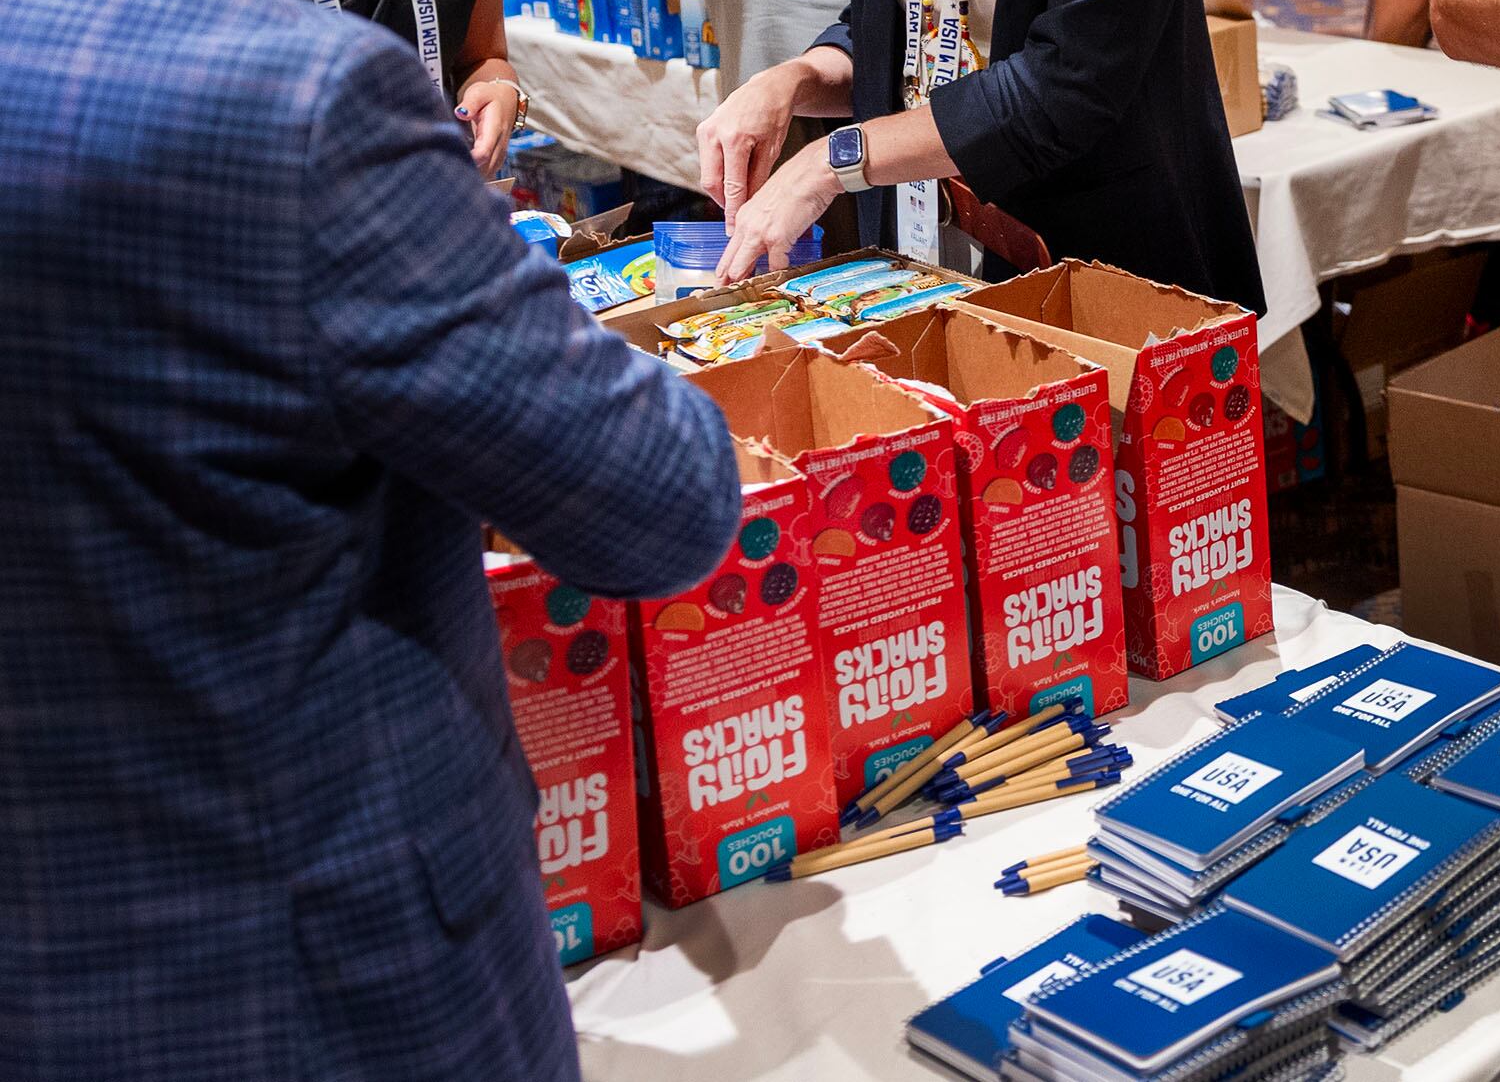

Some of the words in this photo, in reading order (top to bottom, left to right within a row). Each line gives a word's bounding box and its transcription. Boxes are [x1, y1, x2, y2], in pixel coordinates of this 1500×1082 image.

[423, 28, 438, 63] TEAM
[940, 18, 959, 53] USA
[1213, 335, 1231, 347] FREE
[1231, 327, 1249, 341] GLUTEN
[1175, 340, 1208, 360] NATURALLY
[1150, 357, 1164, 368] FREE
[1055, 393, 1071, 404] FREE
[1071, 384, 1097, 398] GLUTEN
[978, 415, 996, 426] FREE
[1185, 418, 1200, 431] CHERRY
[1234, 405, 1256, 430] RASPBERRY
[1196, 484, 1229, 502] FLAVORED
[1230, 476, 1249, 491] FRUIT
[1168, 498, 1195, 513] SNACKS
[1076, 542, 1099, 557] FRUIT
[1035, 550, 1075, 570] FLAVORED
[1002, 563, 1034, 581] SNACKS
[915, 595, 942, 610] FRUIT
[1211, 589, 1240, 609] Member's
[870, 604, 915, 624] FLAVORED
[1197, 609, 1235, 632] POUCHES
[833, 618, 868, 636] SNACKS
[1198, 622, 1238, 652] 100
[1053, 661, 1089, 679] Member's
[721, 679, 771, 702] FLAVORED
[1038, 683, 1083, 706] POUCHES
[1361, 692, 1406, 713] USA
[1332, 705, 1354, 716] ONE
[1352, 709, 1374, 722] FOR
[1372, 715, 1391, 729] ALL
[874, 744, 923, 768] POUCHES
[1202, 768, 1250, 793] USA
[727, 824, 783, 853] POUCHES
[728, 838, 786, 876] 100
[1347, 838, 1398, 869] USA
[1152, 965, 1206, 993] USA
